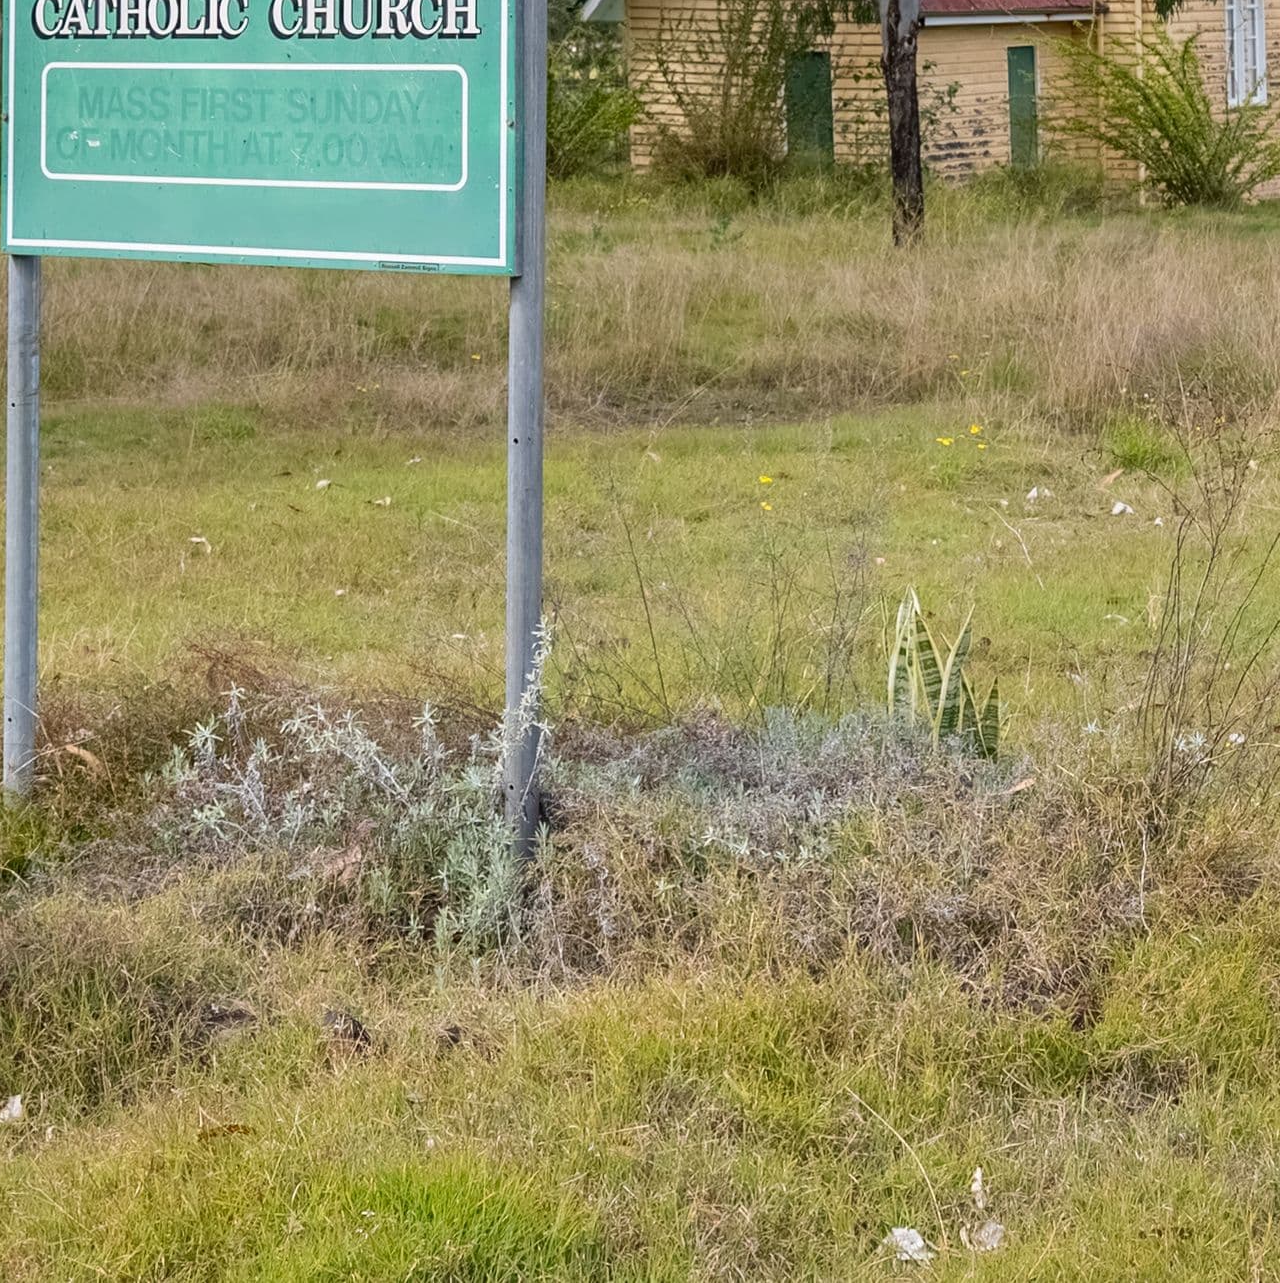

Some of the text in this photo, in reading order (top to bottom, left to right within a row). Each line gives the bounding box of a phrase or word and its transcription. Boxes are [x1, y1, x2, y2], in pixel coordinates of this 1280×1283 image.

[78, 85, 426, 125] MASS FIRST SUNDAY
[56, 126, 99, 161] OF
[110, 126, 226, 166] MONTH
[241, 131, 280, 166] AT
